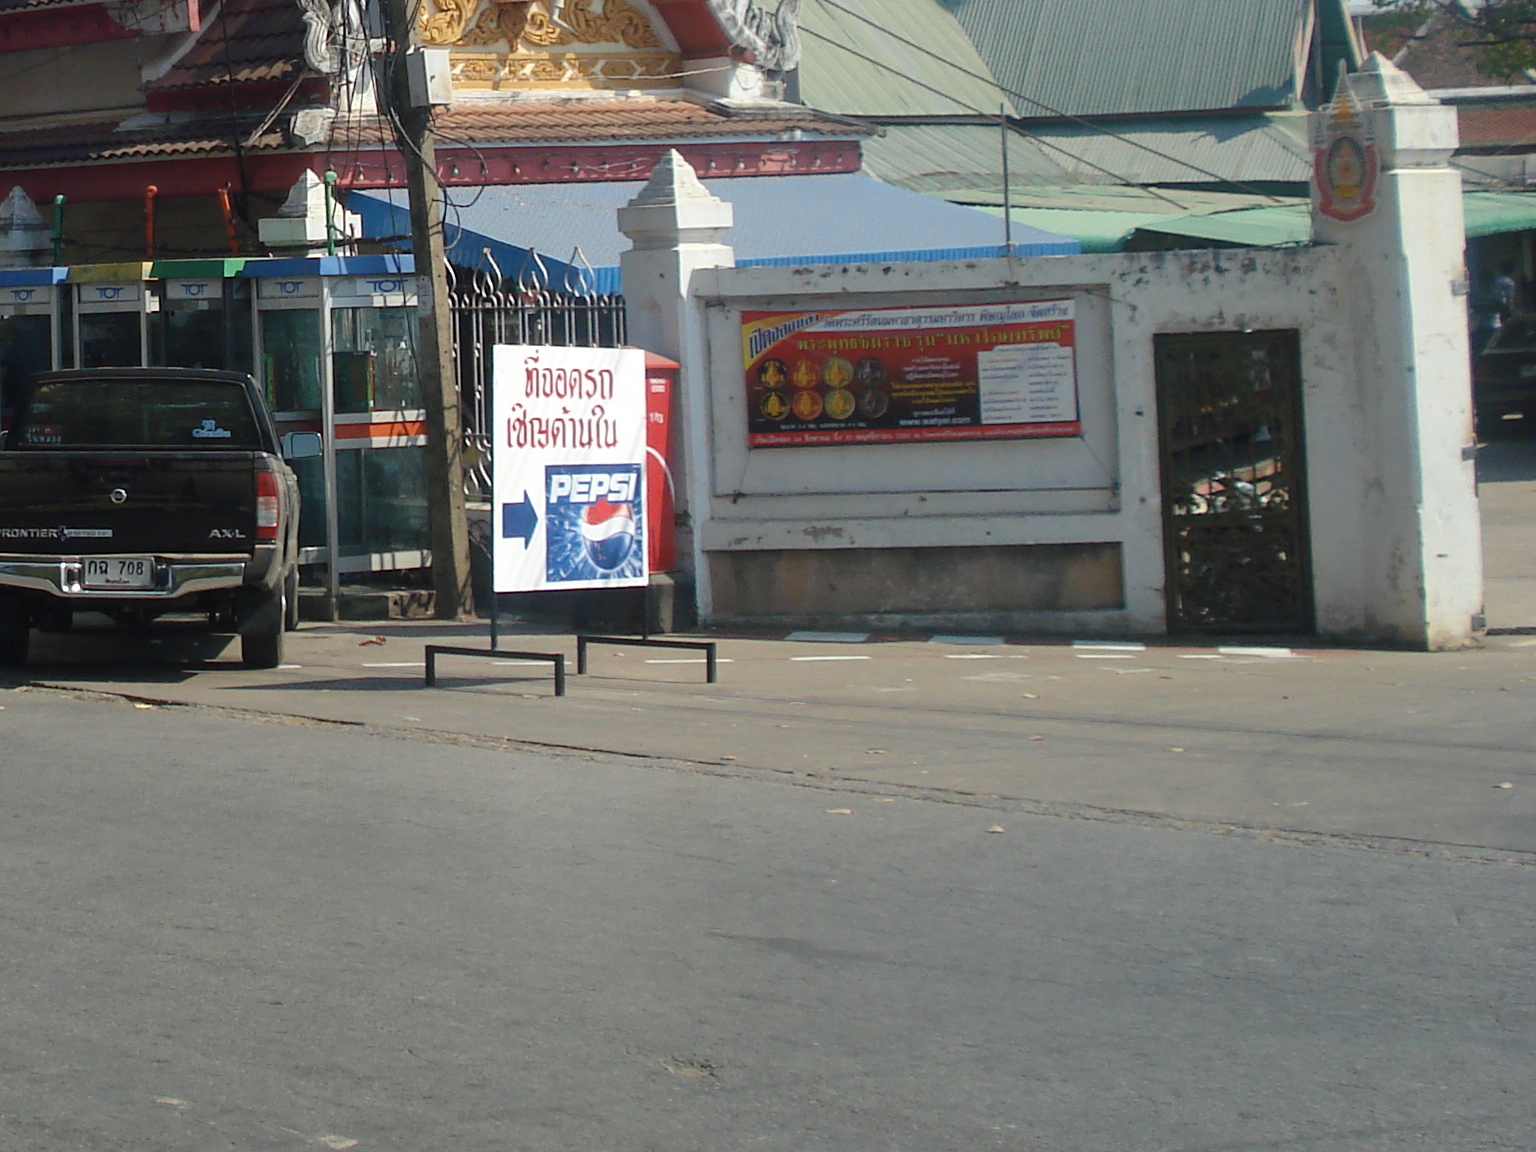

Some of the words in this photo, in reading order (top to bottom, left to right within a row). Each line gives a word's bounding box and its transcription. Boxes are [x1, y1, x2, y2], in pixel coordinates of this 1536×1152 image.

[95, 286, 125, 299] TOT
[180, 283, 208, 296] TOT
[275, 281, 305, 295] TOT
[366, 279, 408, 293] TOT
[10, 289, 36, 301] TOT
[524, 349, 614, 400] ที่จอดรถ
[507, 402, 619, 449] เชิญด้านใน
[549, 472, 638, 504] PEPSI
[119, 560, 145, 576] 708
